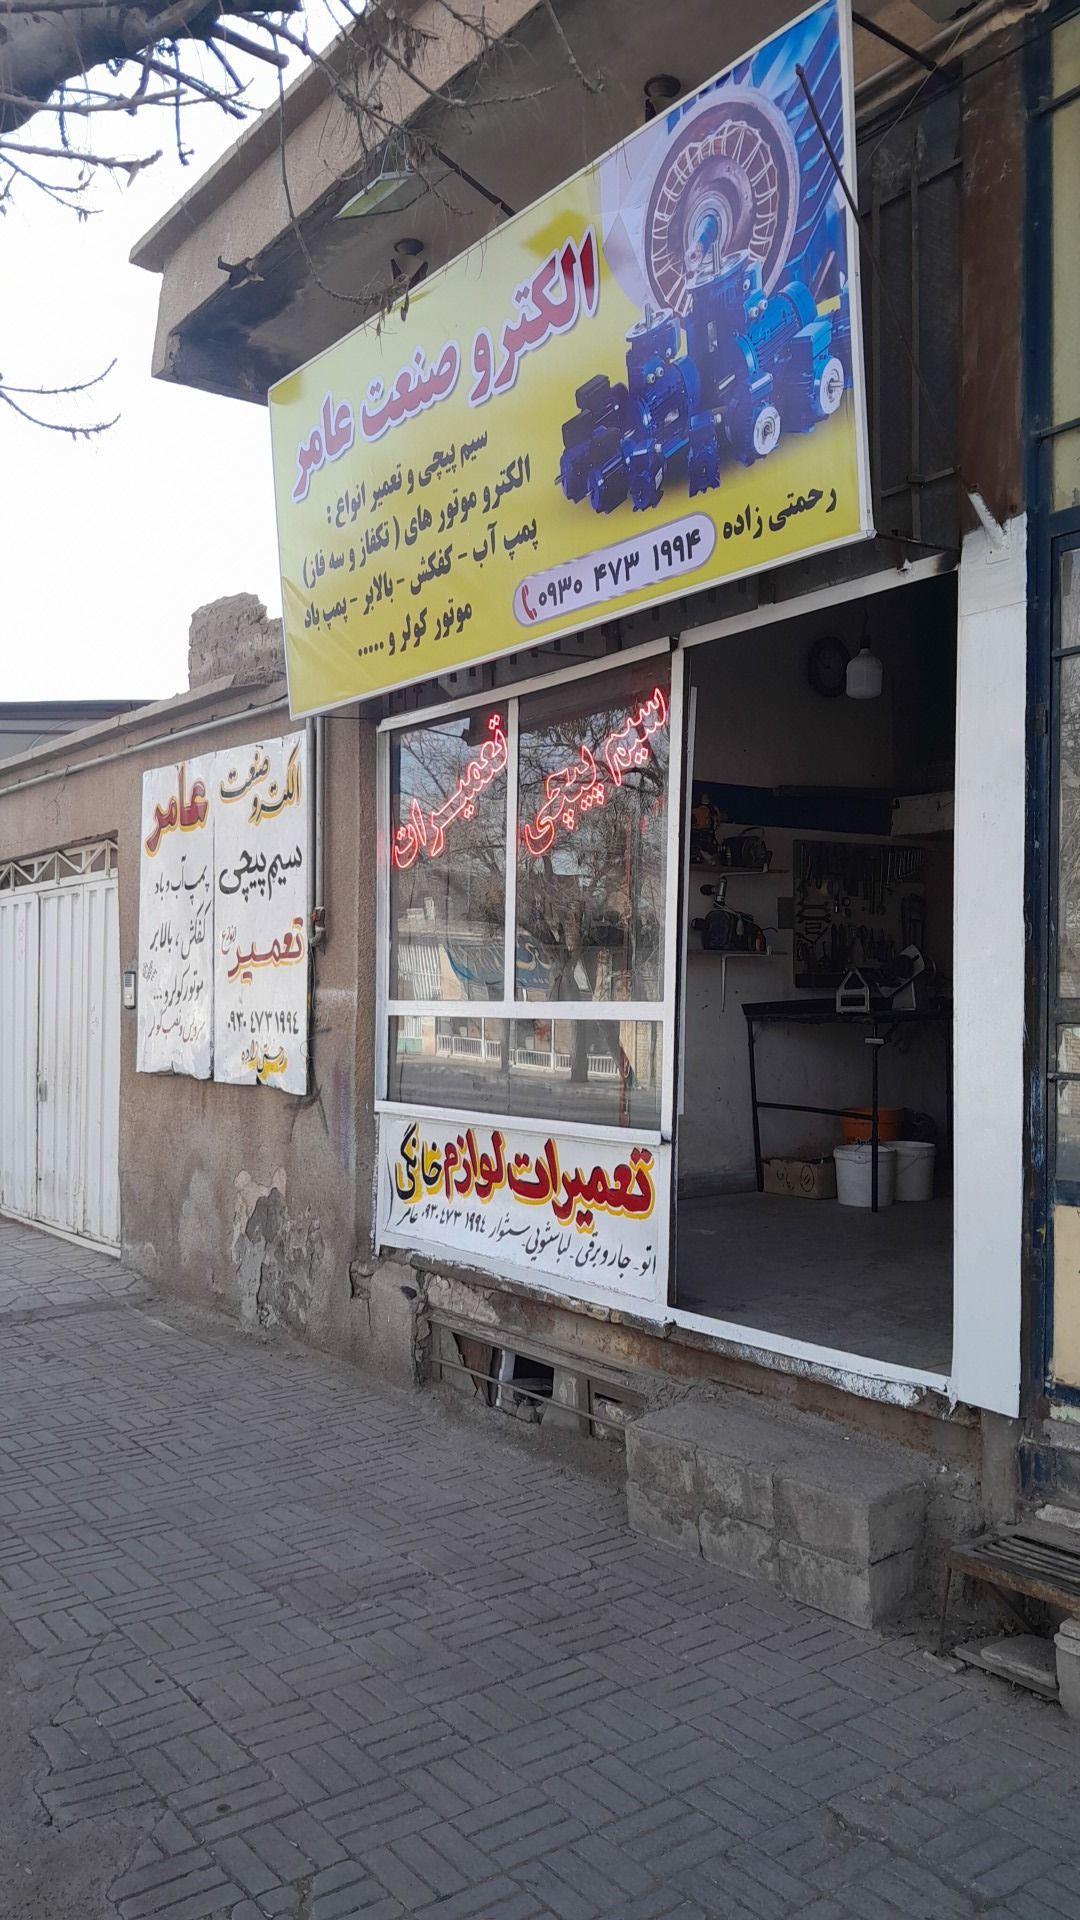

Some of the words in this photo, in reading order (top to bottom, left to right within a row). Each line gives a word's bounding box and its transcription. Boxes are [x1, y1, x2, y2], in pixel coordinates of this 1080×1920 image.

[469, 229, 598, 403] الکترو
[360, 344, 459, 440] صنعت
[292, 395, 353, 500] عامر
[418, 444, 455, 486] پیچی
[461, 430, 488, 468] سیم
[370, 464, 402, 512] تعمیر
[407, 469, 414, 494] و
[482, 454, 530, 513] الکترو
[404, 505, 432, 546] های
[438, 490, 476, 533] موتور
[723, 504, 762, 540] زاده
[768, 487, 836, 532] رحمتی
[329, 552, 344, 570] سه
[349, 548, 355, 571] و
[473, 521, 498, 568] آب
[504, 518, 538, 560] پمپ
[410, 544, 452, 594] کفکش
[304, 602, 320, 630] باد
[322, 597, 347, 630] پمپ
[363, 572, 394, 615] بالابر
[400, 608, 427, 652] کولر
[434, 599, 472, 640] موتور
[606, 688, 668, 786] سیم
[220, 752, 269, 802] صنعت
[250, 737, 301, 824] الکترو
[394, 714, 508, 868] تعمیرات
[145, 764, 208, 857] عامر
[524, 746, 604, 854] پیچی
[154, 872, 164, 900] باد
[171, 854, 186, 899] آب
[184, 866, 210, 905] پمپ
[219, 850, 266, 902] پیچی
[268, 844, 302, 901] سیم
[228, 917, 304, 984] تعمیر
[168, 963, 190, 1006] کولر
[183, 970, 204, 1001] موتور
[394, 1121, 444, 1203] خانگی
[442, 1128, 504, 1203] لوازم
[507, 1138, 655, 1232] تعمیرات
